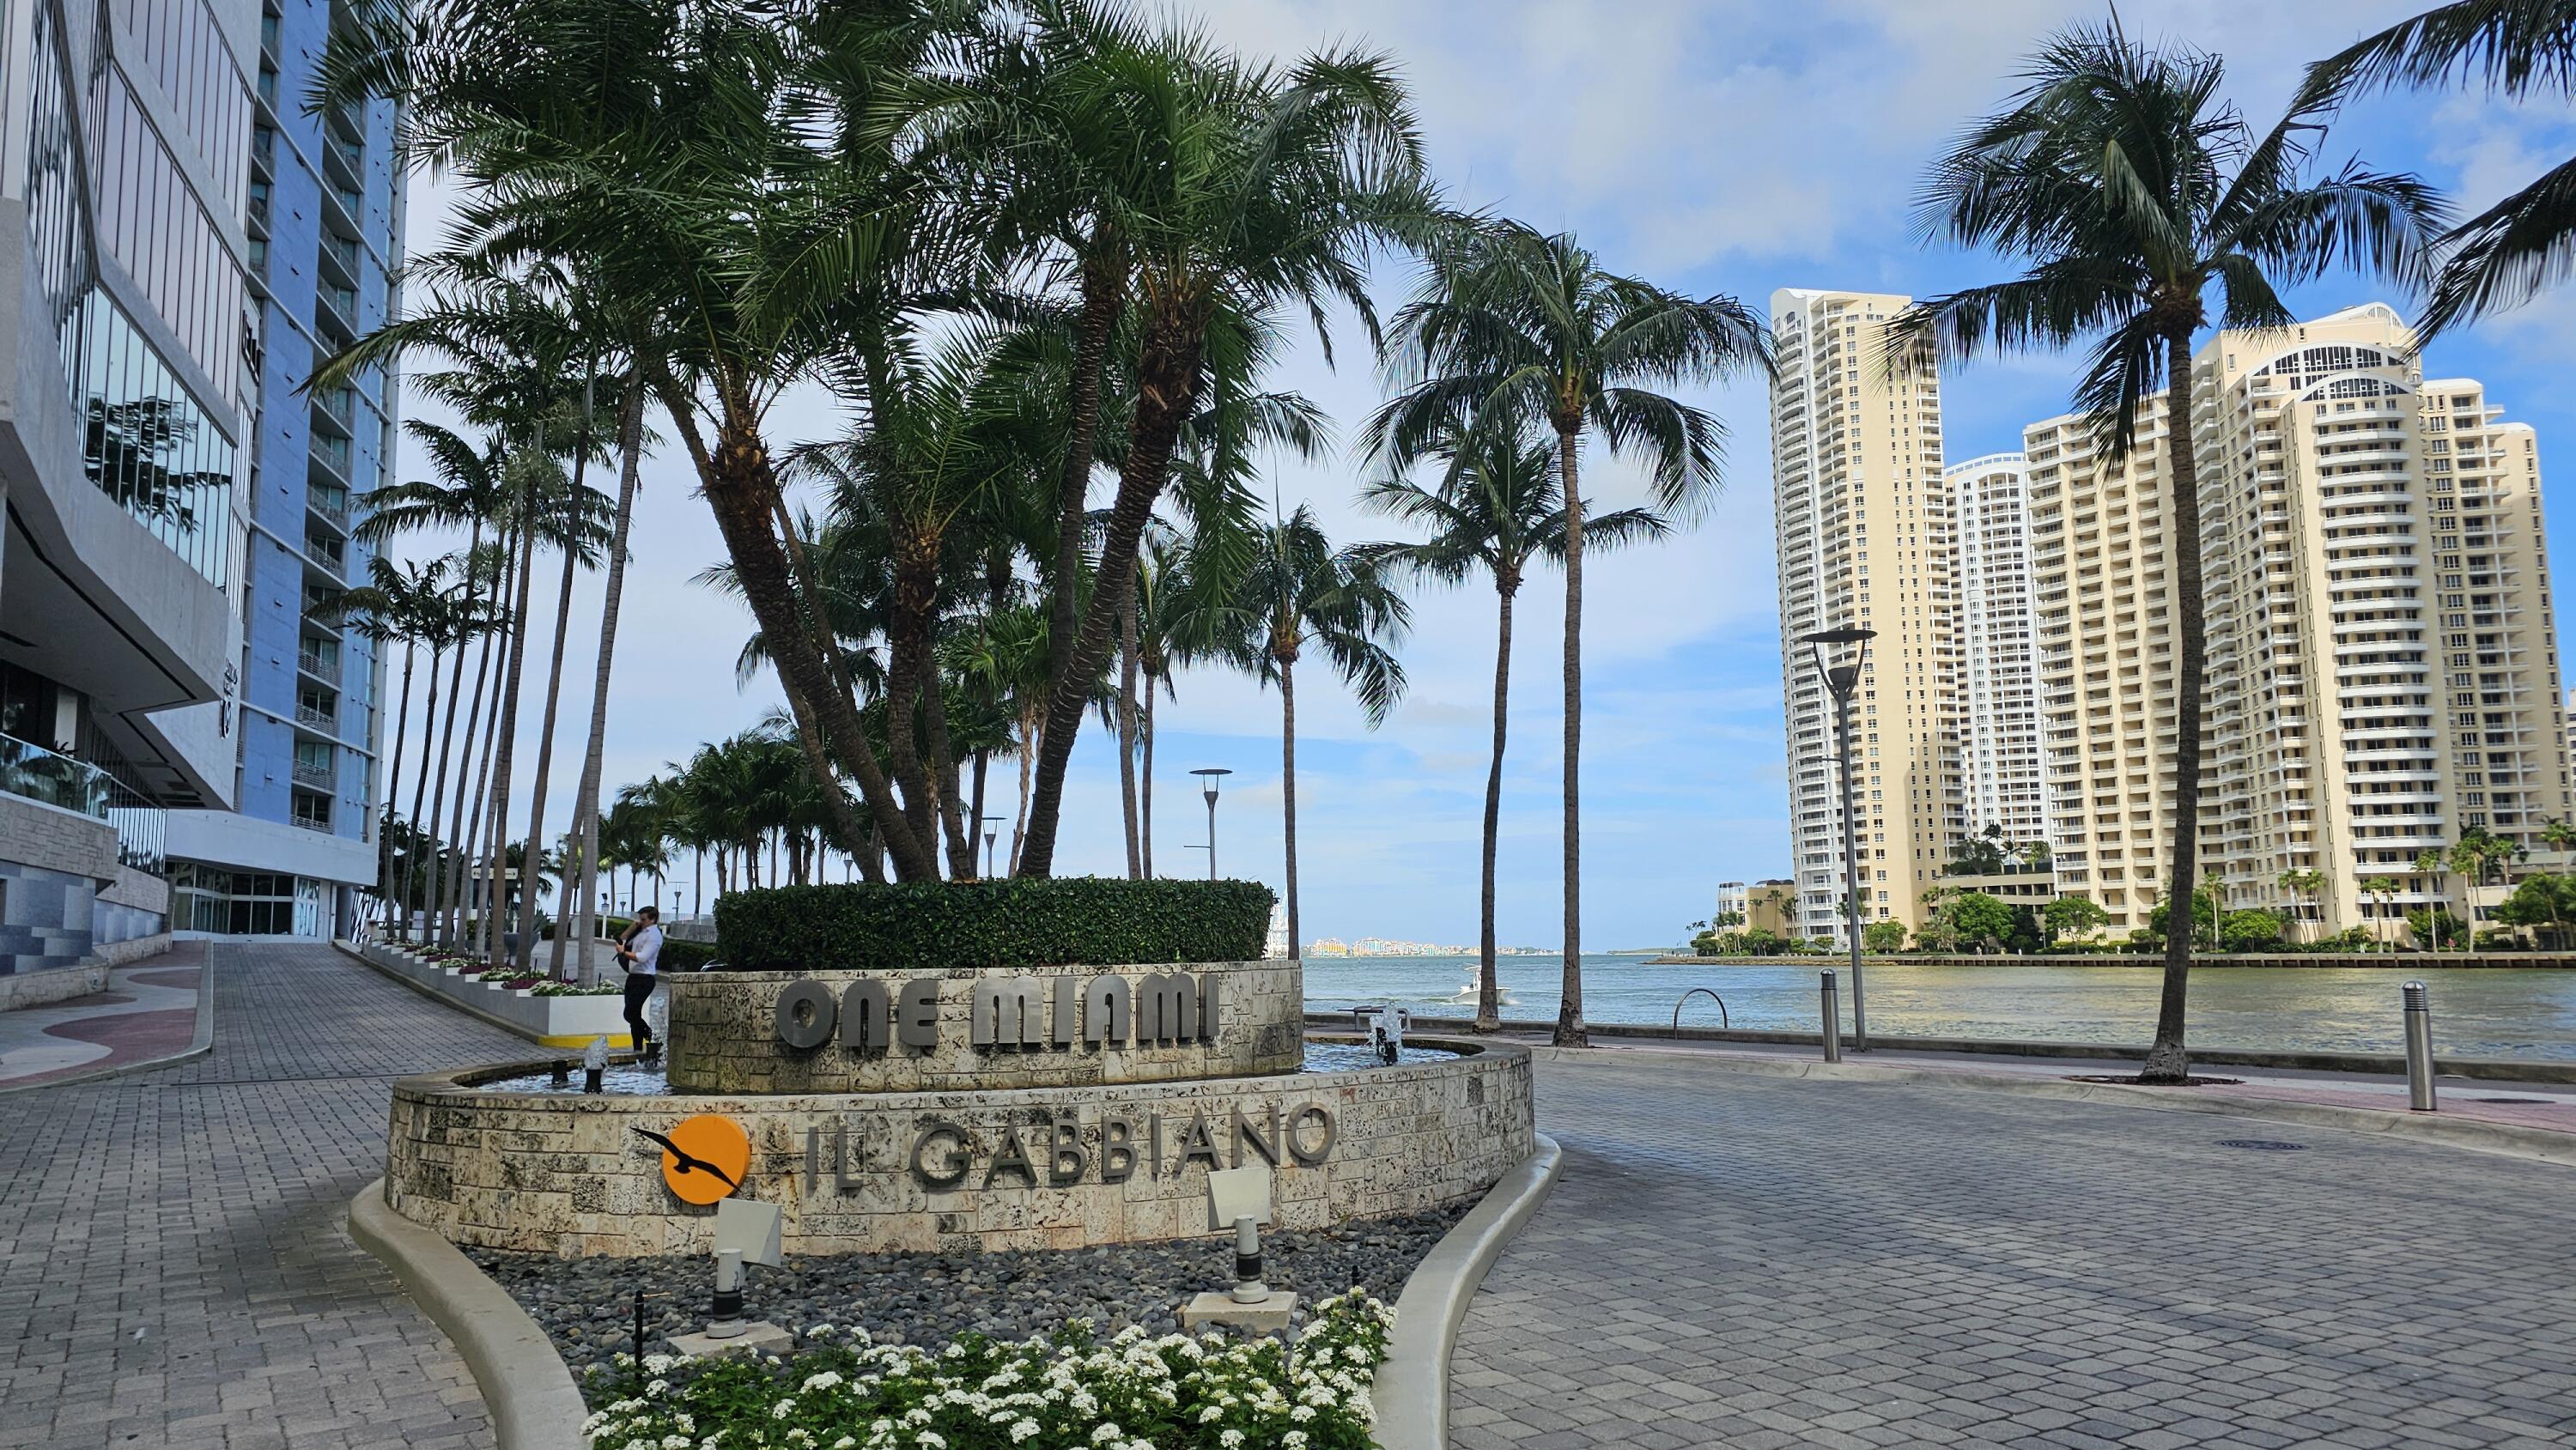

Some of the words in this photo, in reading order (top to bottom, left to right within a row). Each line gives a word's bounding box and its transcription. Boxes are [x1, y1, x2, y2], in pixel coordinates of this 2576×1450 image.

[775, 979, 939, 1048] ONE
[973, 974, 1219, 1044] MIAMI
[806, 1125, 863, 1191] IL
[910, 1101, 1338, 1186] GABBIANO
